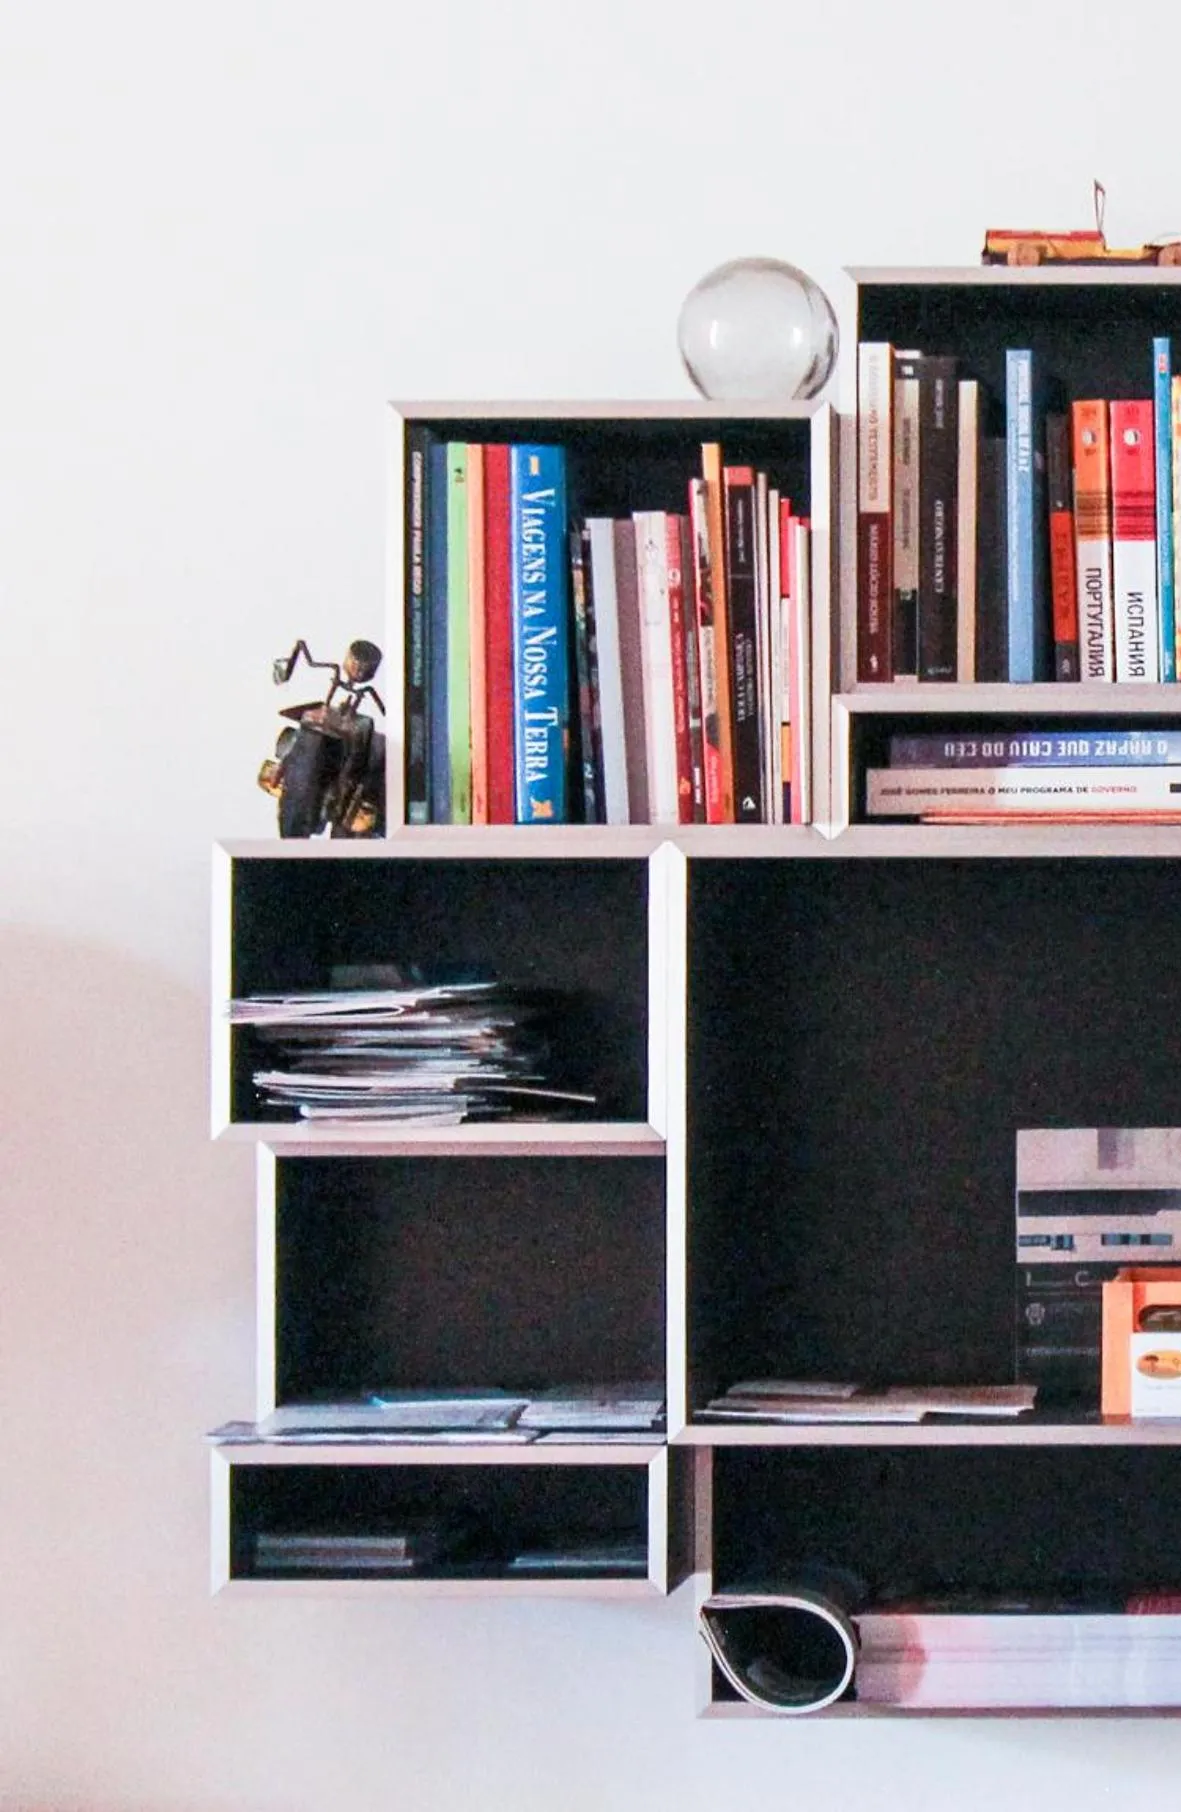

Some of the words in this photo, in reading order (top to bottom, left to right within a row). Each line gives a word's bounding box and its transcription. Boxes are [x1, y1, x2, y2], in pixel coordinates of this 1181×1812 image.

[521, 487, 556, 585] VIAGENS
[522, 587, 540, 619] NA
[1085, 567, 1105, 679] ПОРТУГАЛИЯ
[1126, 591, 1146, 678] ИСПАНИЯ
[522, 626, 558, 699] NOSSA
[523, 706, 559, 784] TERRA
[981, 739, 1006, 756] DO
[1009, 739, 1052, 757] CAIU
[1056, 739, 1090, 757] QUE
[1092, 739, 1152, 757] RAPAZ
[1157, 739, 1168, 757] O
[1020, 786, 1074, 795] PROGRAMA
[1076, 785, 1088, 794] DE
